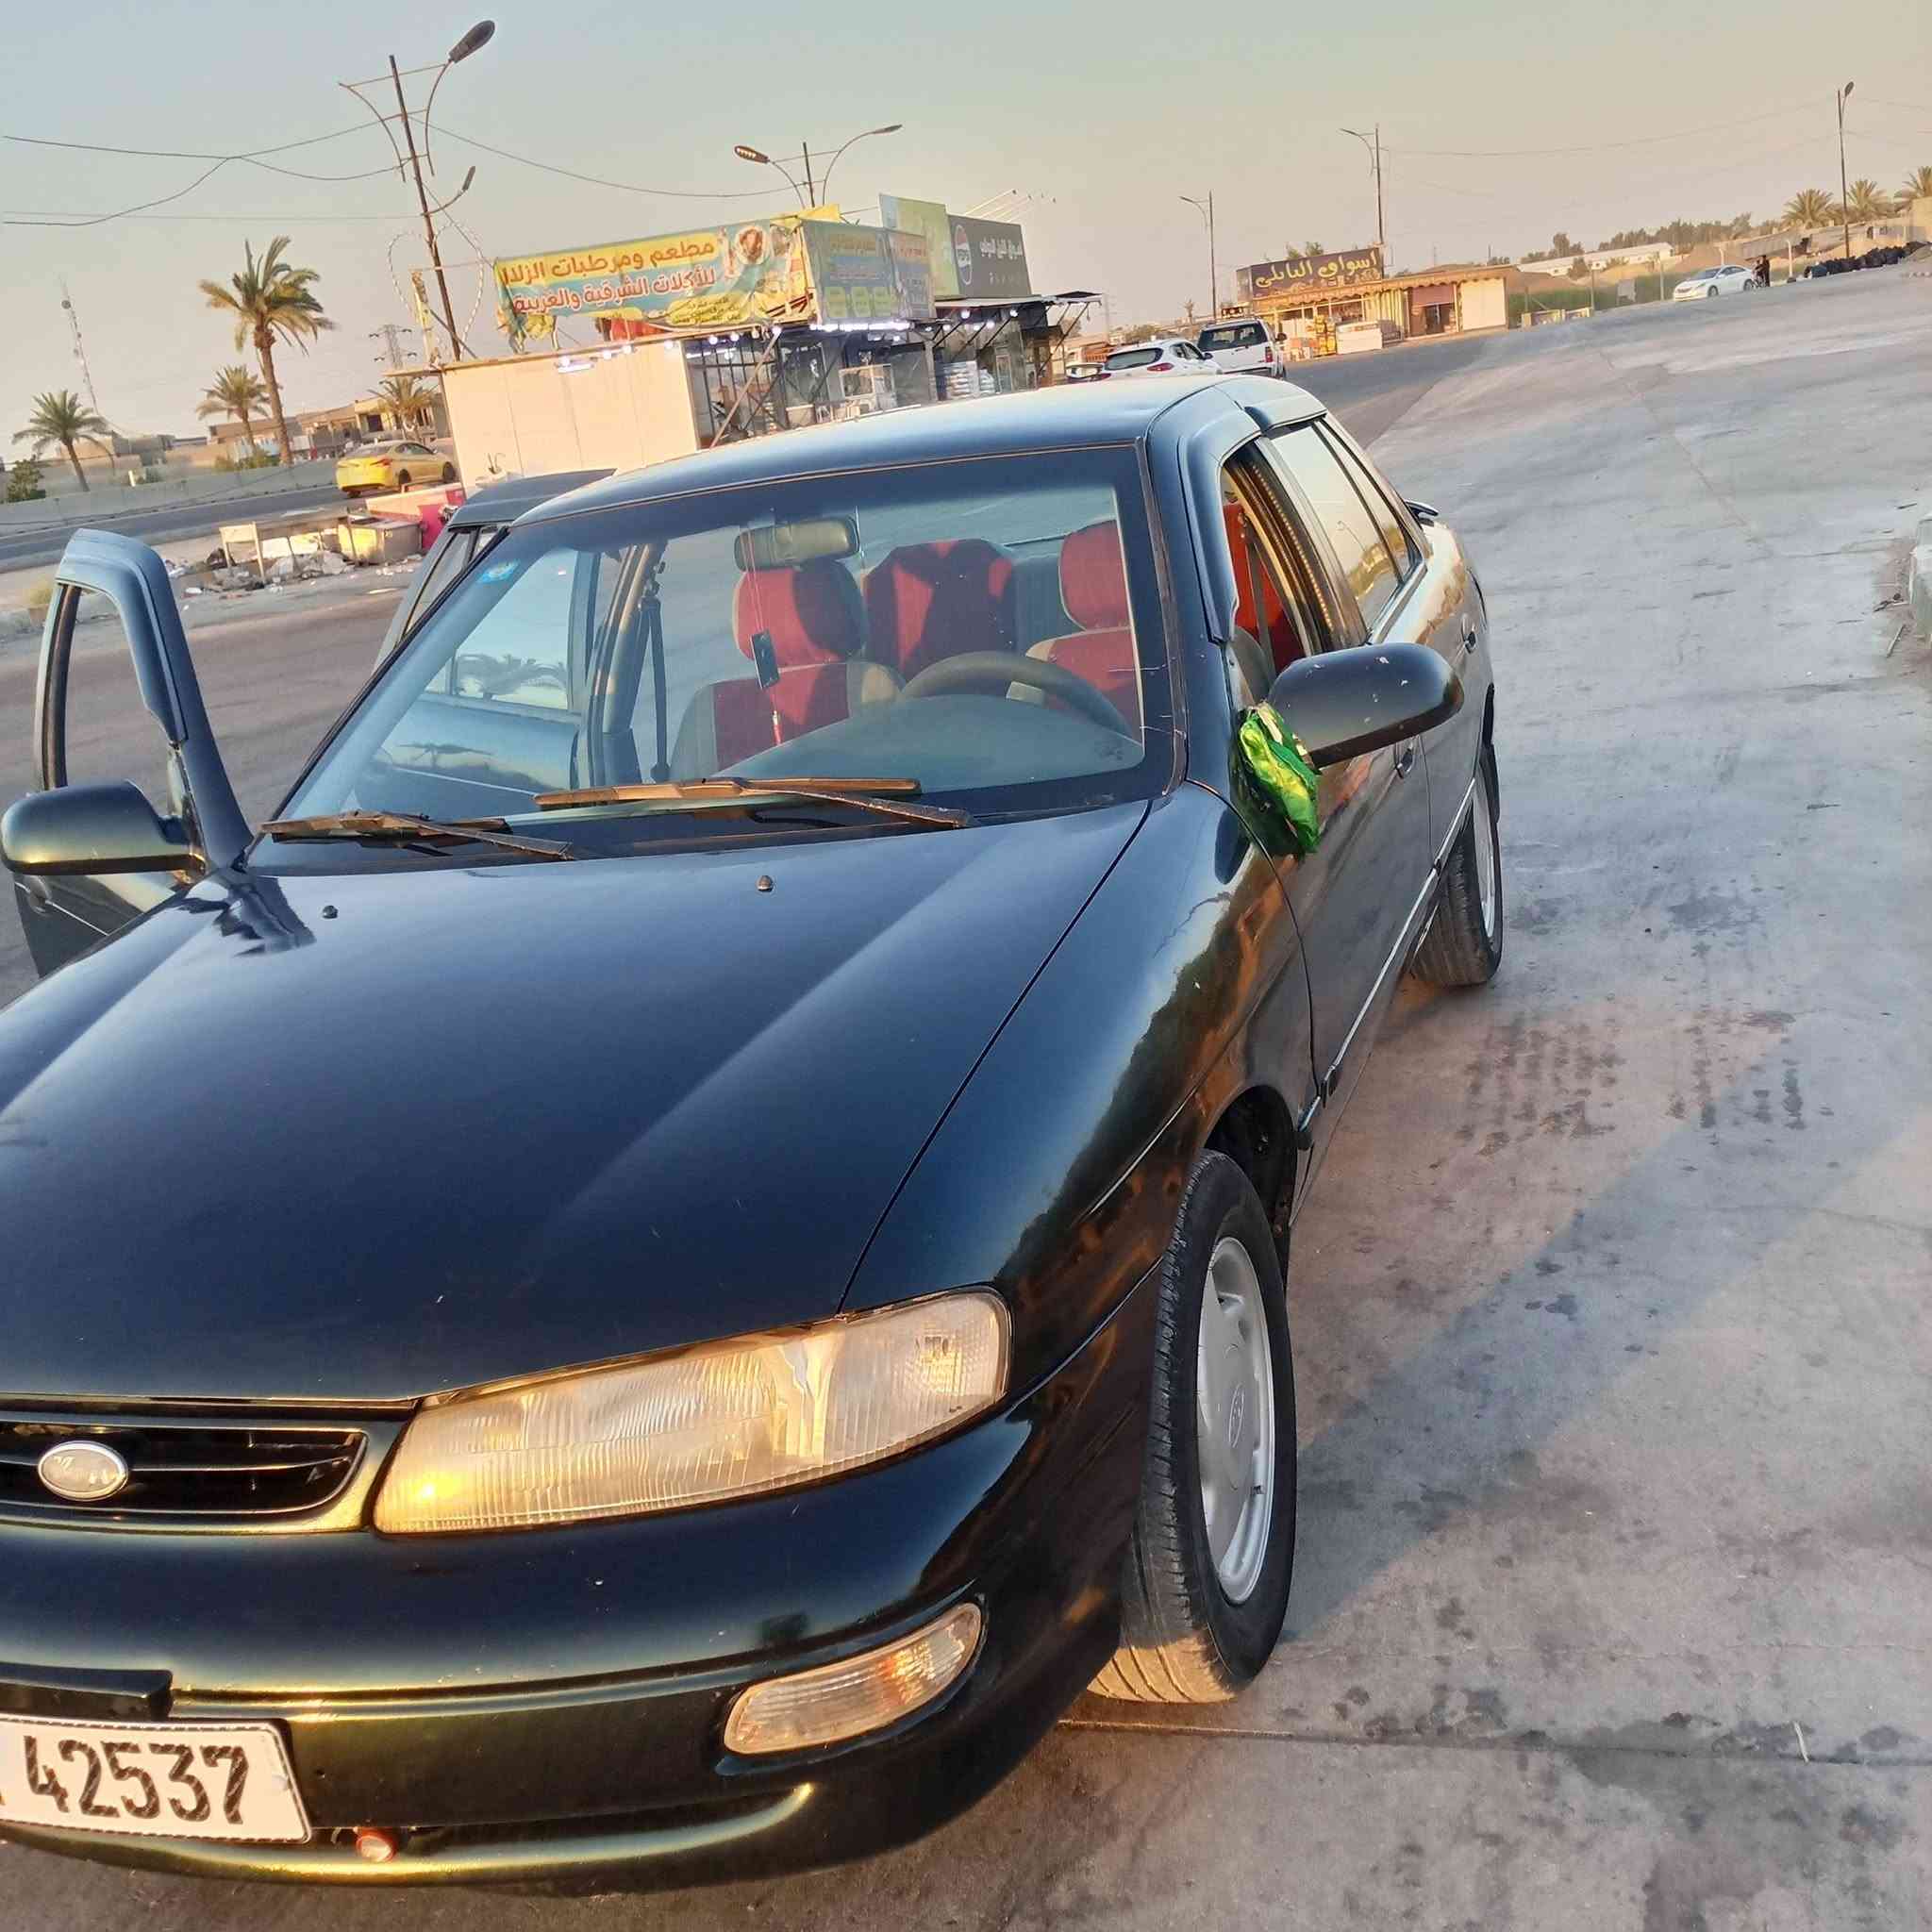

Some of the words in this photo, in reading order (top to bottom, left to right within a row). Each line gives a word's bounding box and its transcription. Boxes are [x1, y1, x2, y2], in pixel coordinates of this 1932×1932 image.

[551, 252, 644, 278] ومرطبات
[649, 241, 715, 266] مطعم
[652, 265, 715, 291] للأكلات
[512, 289, 582, 314] والغربية
[584, 277, 649, 306] الشرقية
[24, 1735, 249, 1824] 42537
